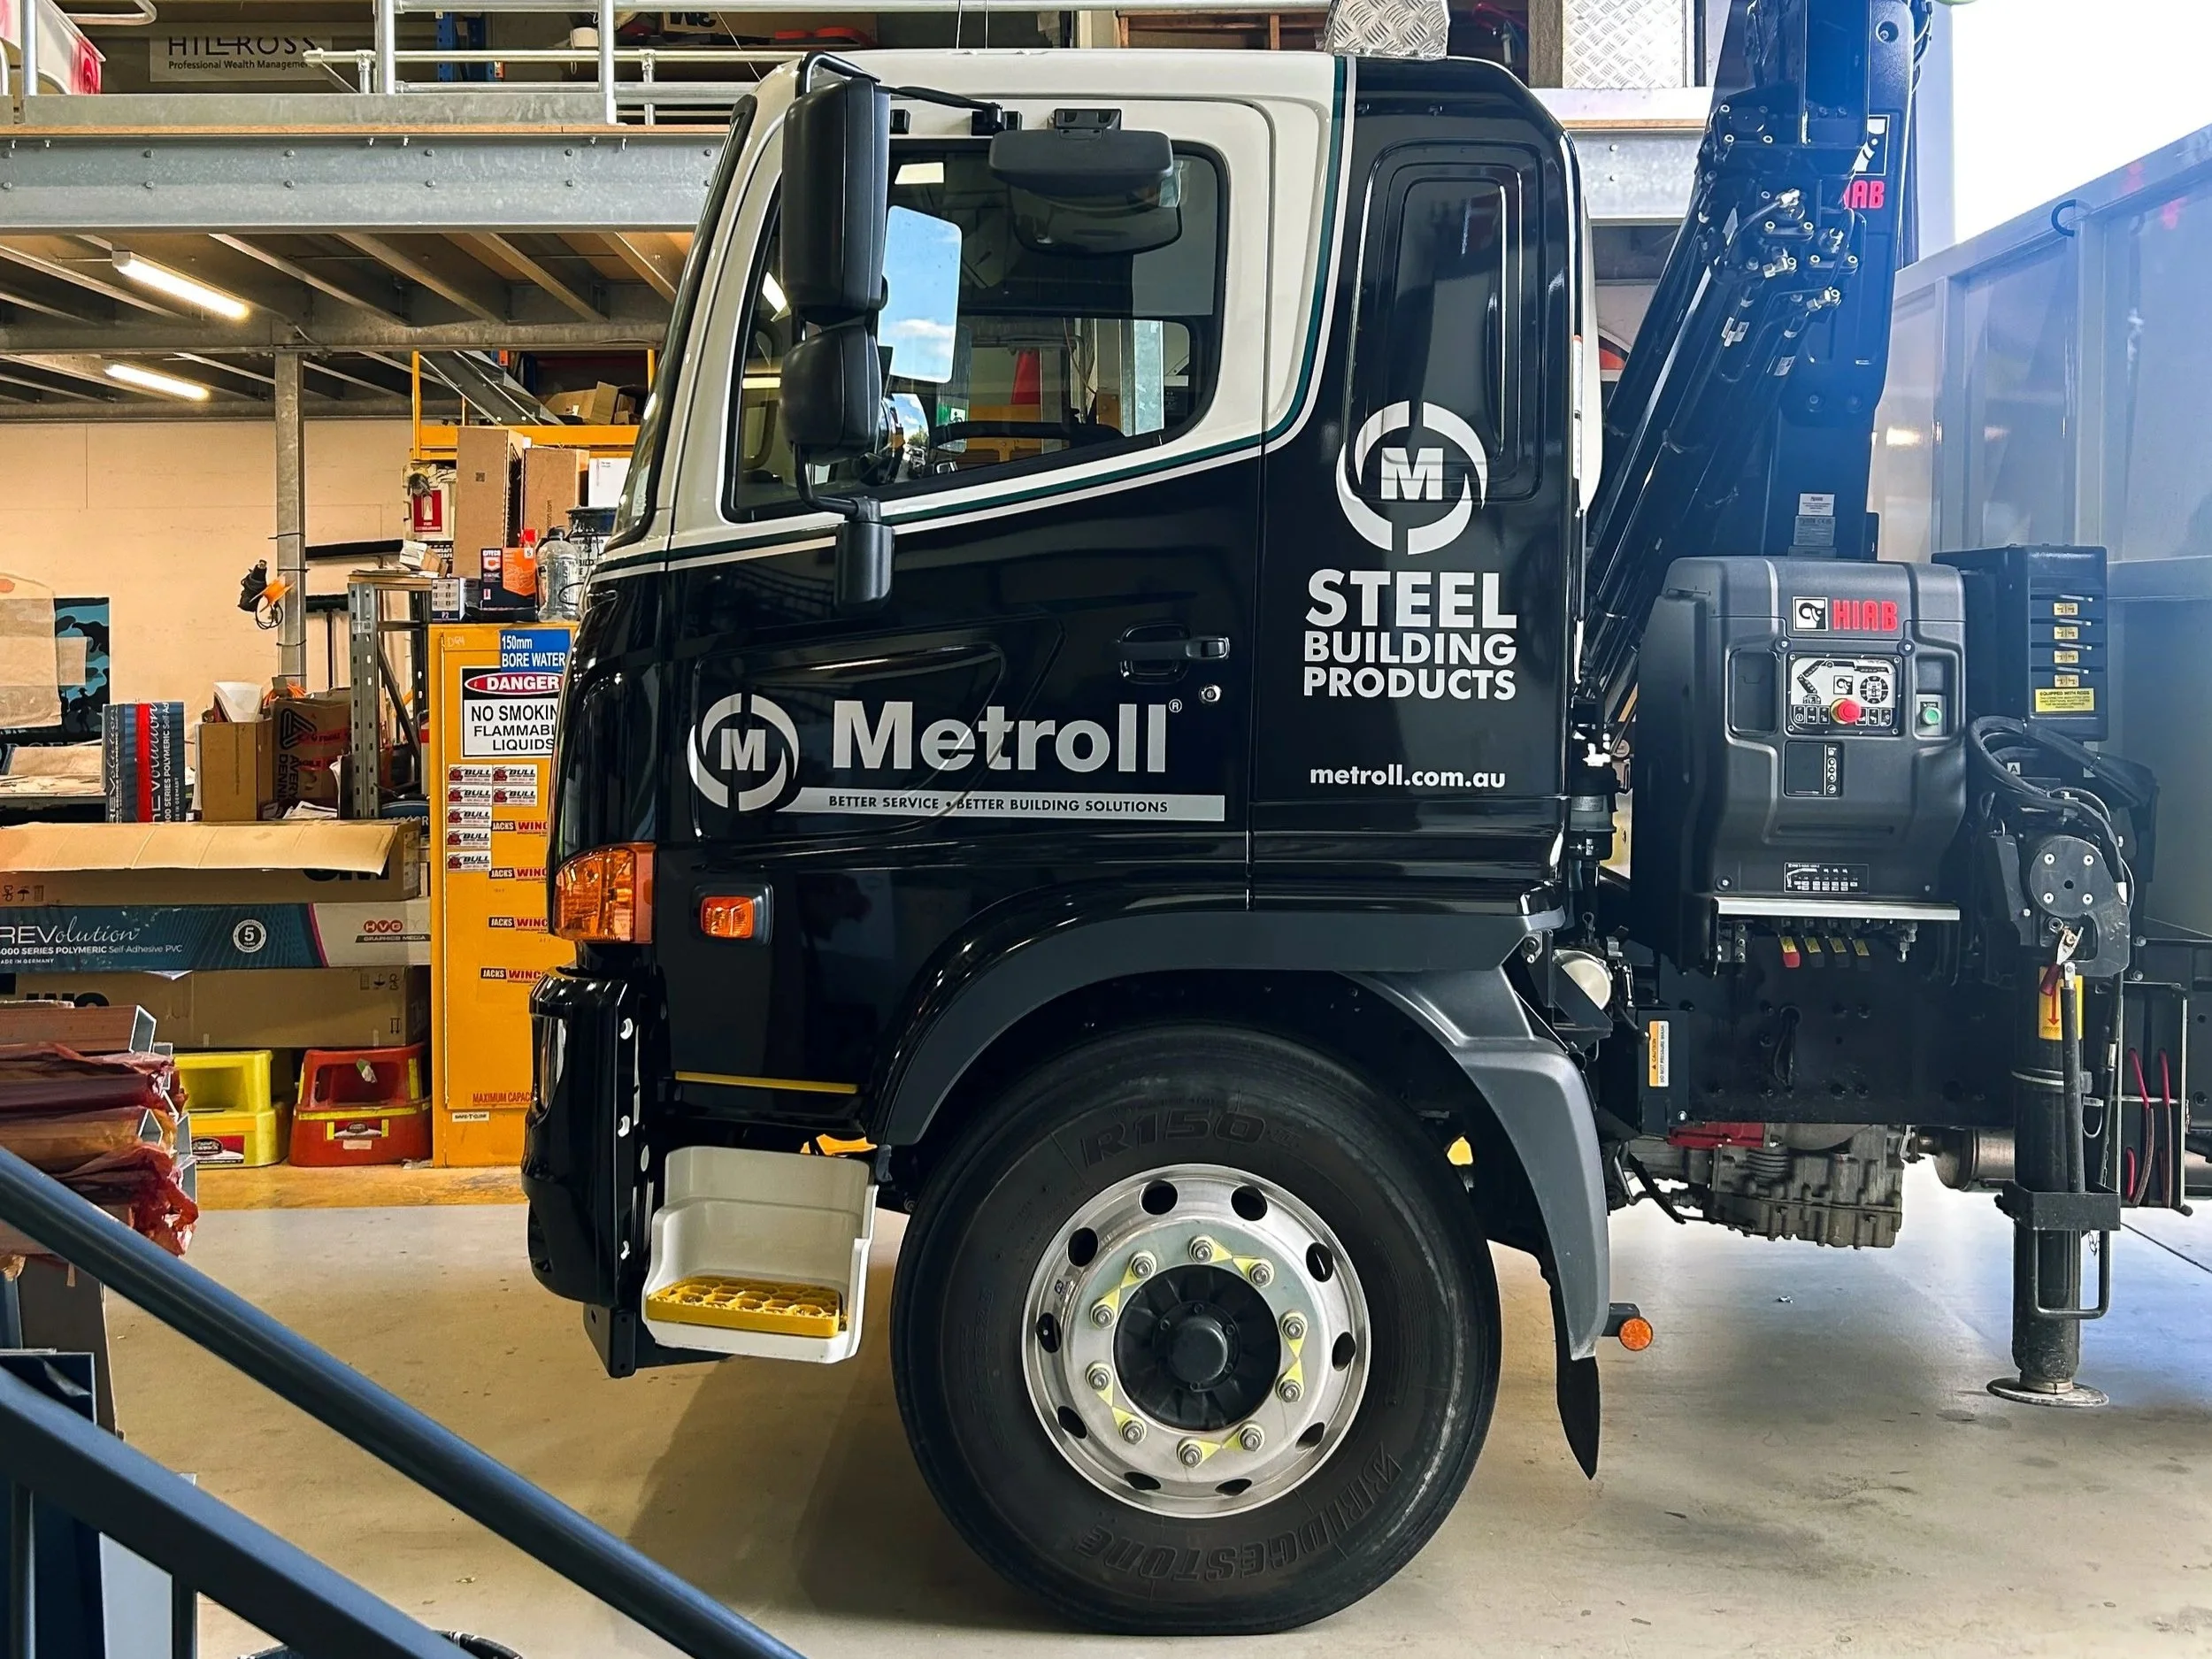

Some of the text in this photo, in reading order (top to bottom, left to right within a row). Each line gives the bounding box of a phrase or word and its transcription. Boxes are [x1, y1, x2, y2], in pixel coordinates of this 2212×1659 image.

[168, 60, 308, 70] Professional Wealth Manageme
[1381, 448, 1444, 501] M
[1305, 569, 1518, 628] STEEL
[1832, 599, 1899, 632] HIAB
[502, 635, 533, 649] 150mm
[1304, 631, 1517, 665] BUILDING
[502, 652, 566, 667] BORE WATER
[487, 676, 560, 690] DANGER
[1303, 667, 1517, 701] PRODUCTS
[471, 705, 494, 722] NO
[493, 738, 554, 751] LIQUIDS
[720, 728, 766, 772] M
[1310, 764, 1506, 787] metroll.com.au
[829, 795, 1168, 813] BETTER SERVICE BETTER BUILDING SOLUTIONS
[244, 927, 254, 941] 5
[364, 920, 403, 933] HVG
[0, 944, 182, 956] 000 SERIES POLYMERIC Self-Adhesive PVC
[472, 1093, 507, 1102] MAXIMUM
[1080, 1109, 1266, 1169] R150
[1075, 1442, 1402, 1584] BRIDGESTONE
